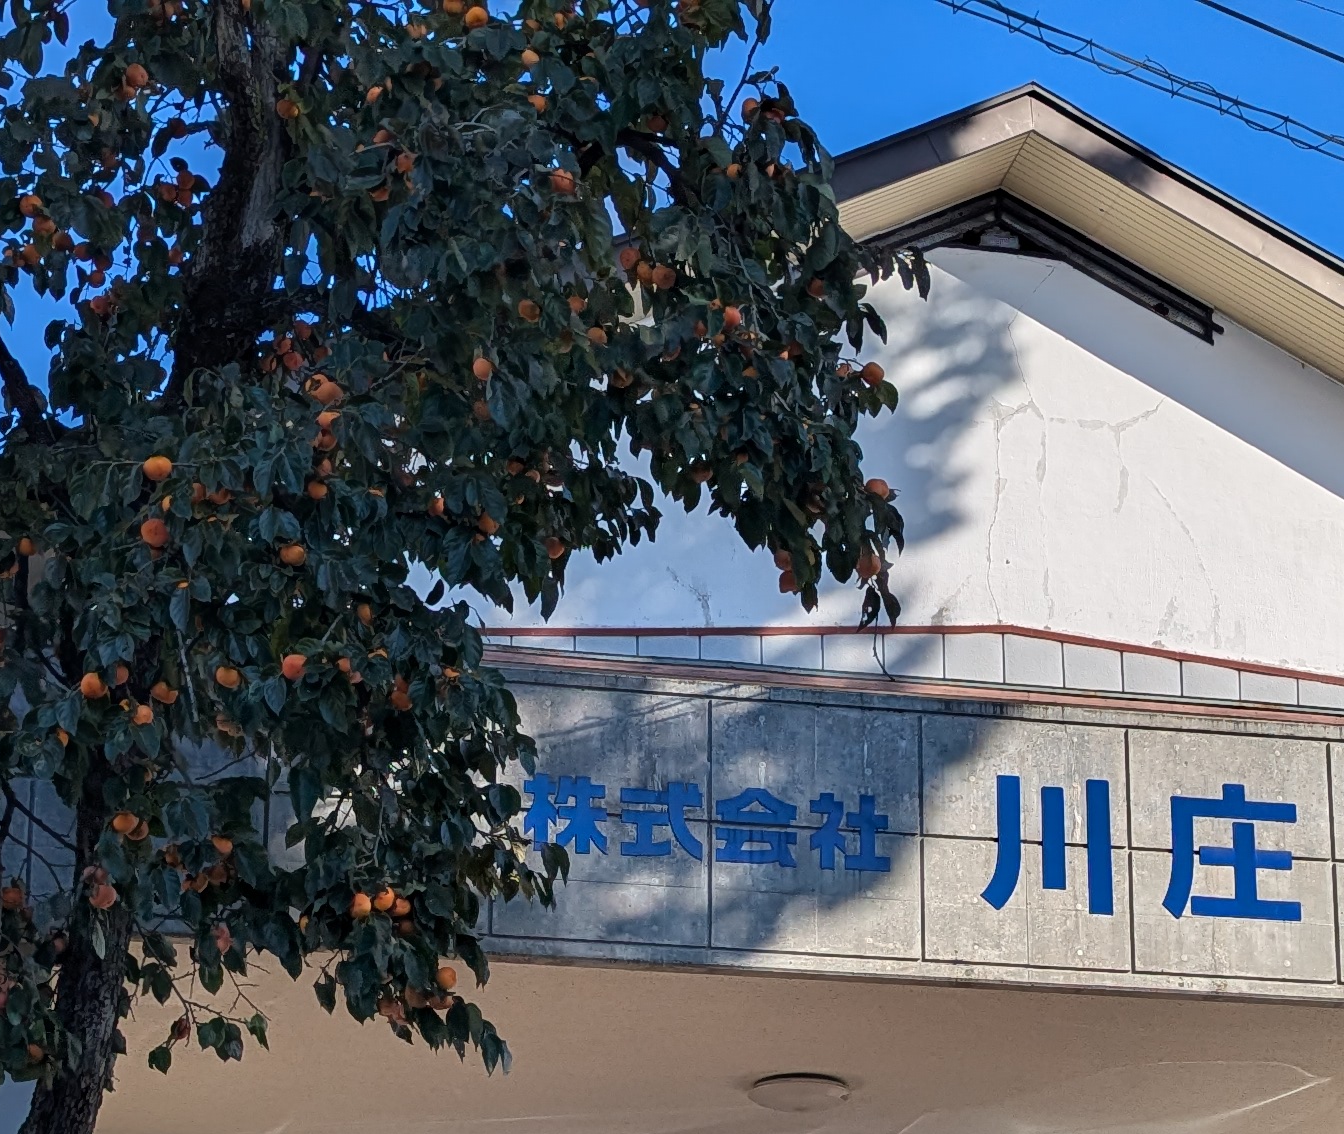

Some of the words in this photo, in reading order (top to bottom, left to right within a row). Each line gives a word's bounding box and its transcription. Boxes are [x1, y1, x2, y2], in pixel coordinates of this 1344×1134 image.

[523, 772, 890, 873] 株式会社
[982, 774, 1302, 921] 川庄
